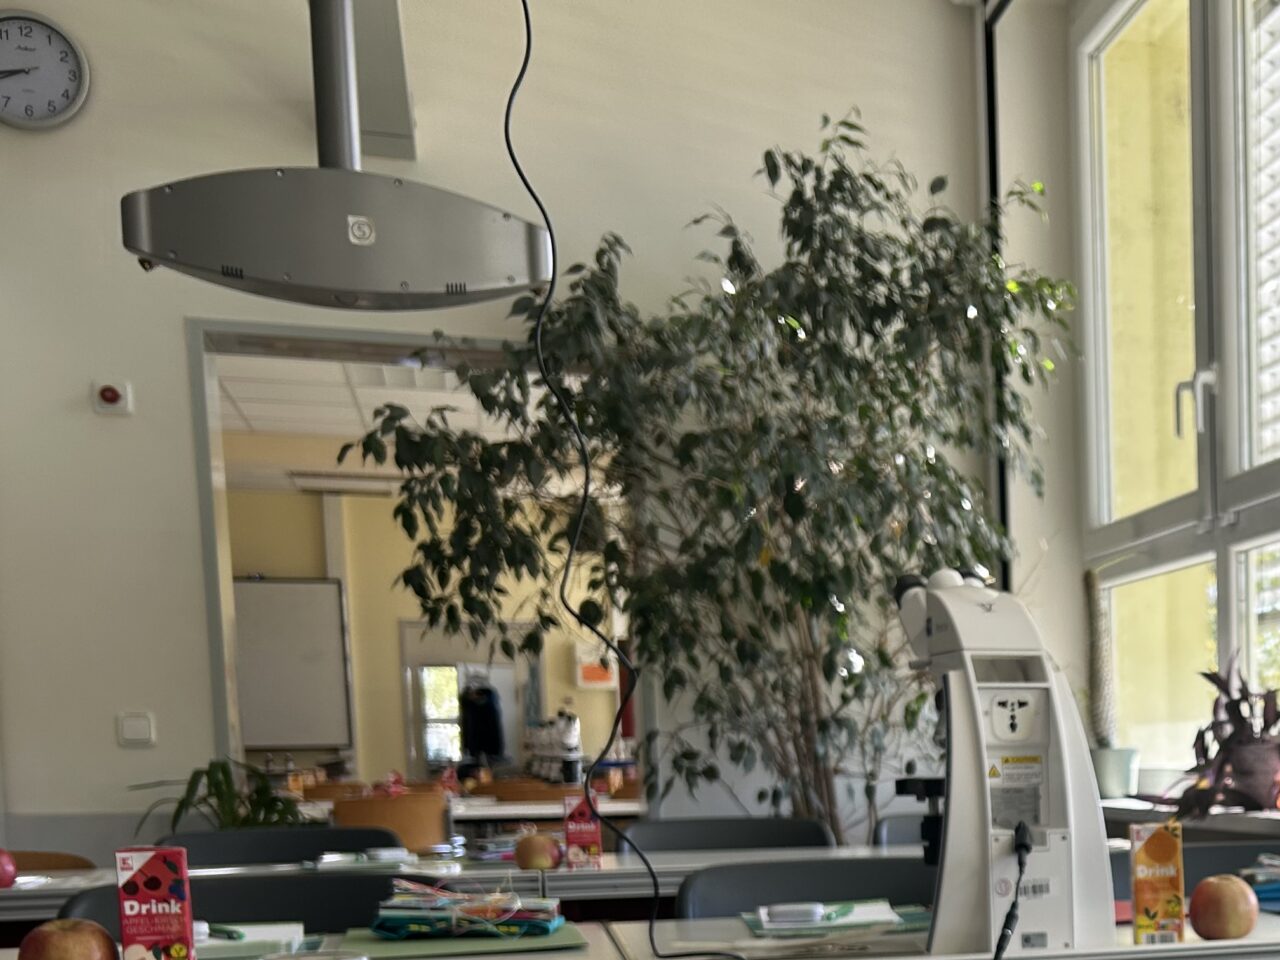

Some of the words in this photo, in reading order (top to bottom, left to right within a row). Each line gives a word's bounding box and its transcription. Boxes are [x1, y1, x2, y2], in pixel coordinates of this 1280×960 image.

[18, 26, 33, 38] 12
[47, 34, 52, 46] 1
[59, 50, 69, 63] 2
[68, 70, 77, 82] 3
[61, 89, 70, 101] 4
[1, 95, 11, 108] 7
[47, 100, 57, 113] 5
[25, 105, 34, 117] 6
[123, 900, 182, 916] Drink
